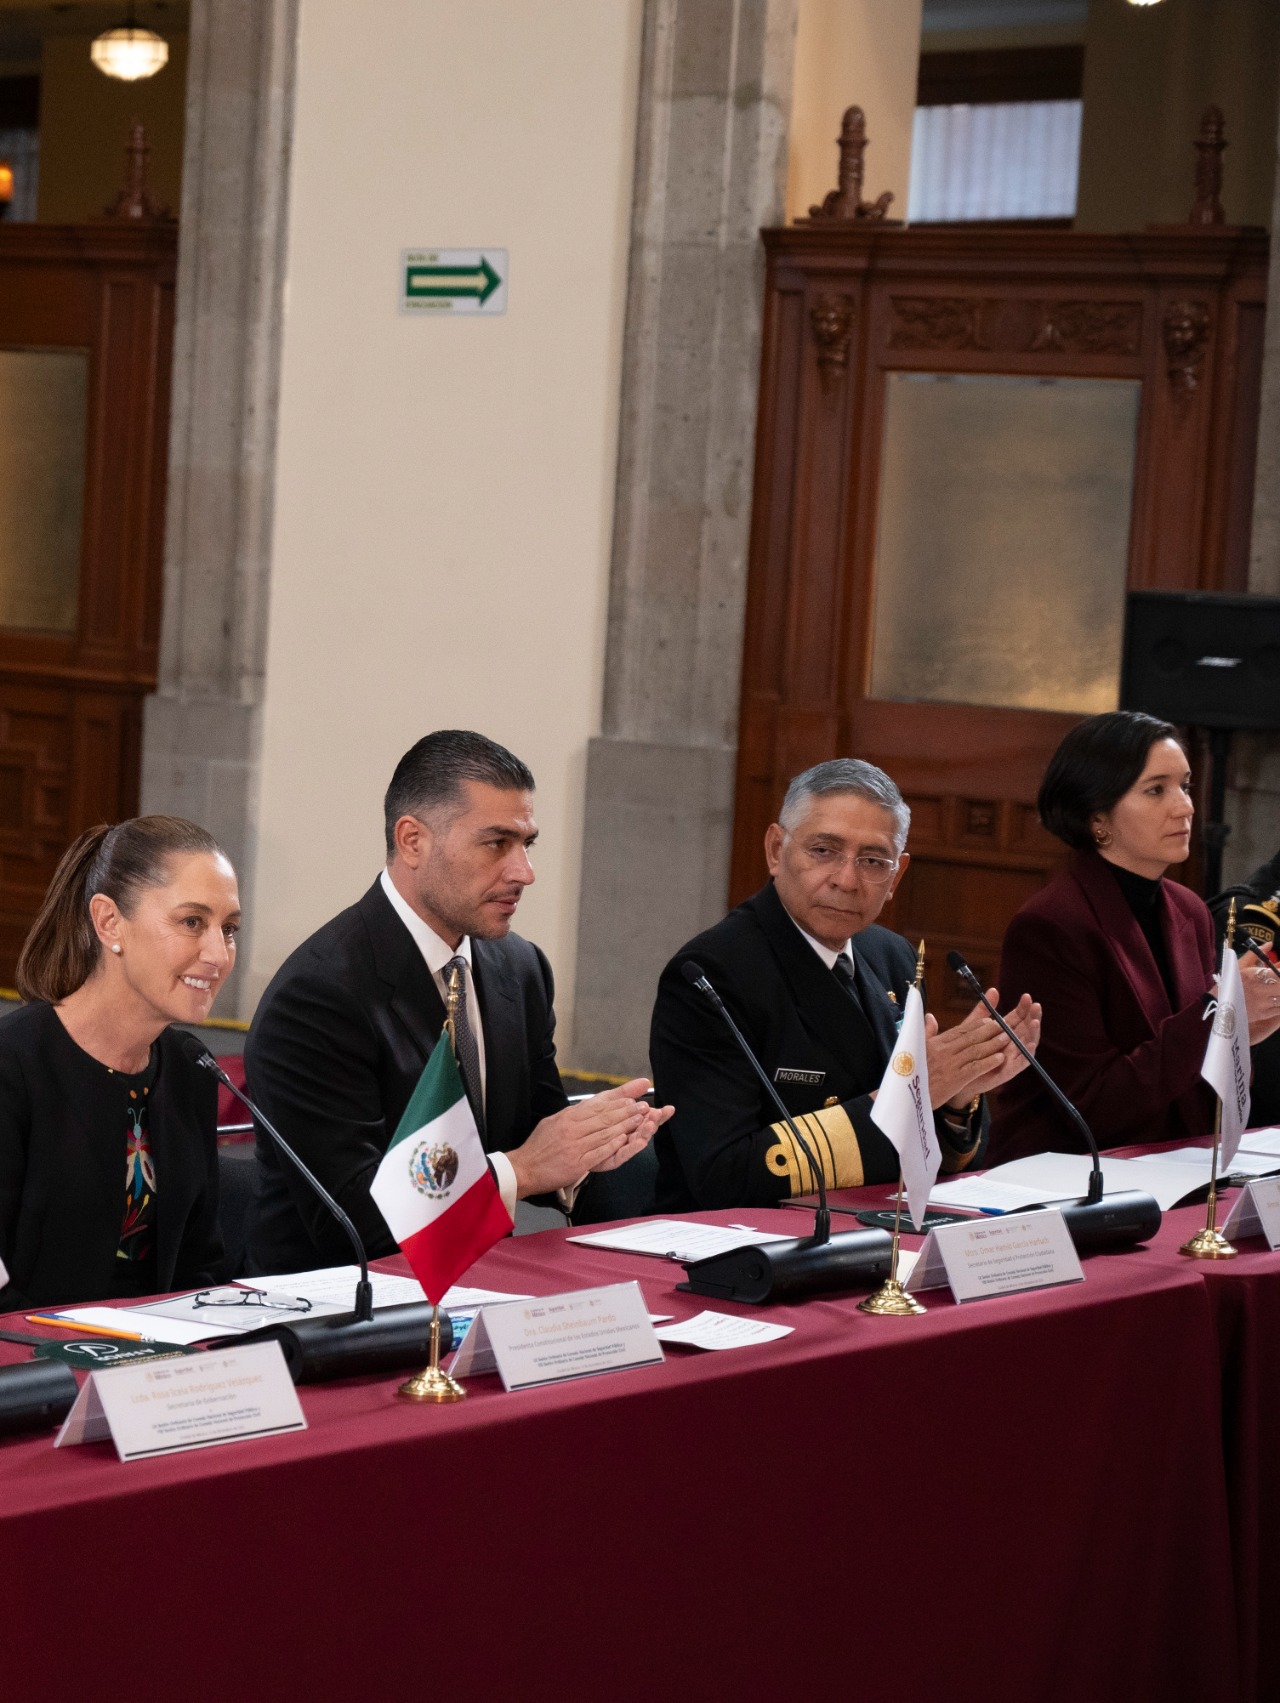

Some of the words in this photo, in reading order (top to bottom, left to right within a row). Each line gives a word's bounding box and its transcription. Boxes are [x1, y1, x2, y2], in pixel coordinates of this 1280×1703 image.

[779, 1071, 821, 1084] MORALES
[1232, 1035, 1248, 1109] Marina
[979, 1245, 995, 1254] Omar
[994, 1242, 1012, 1252] Hamid
[1011, 1239, 1029, 1249] García
[537, 1322, 561, 1334] Claudia
[596, 1312, 617, 1323] Pardo
[150, 1389, 171, 1402] Rosa
